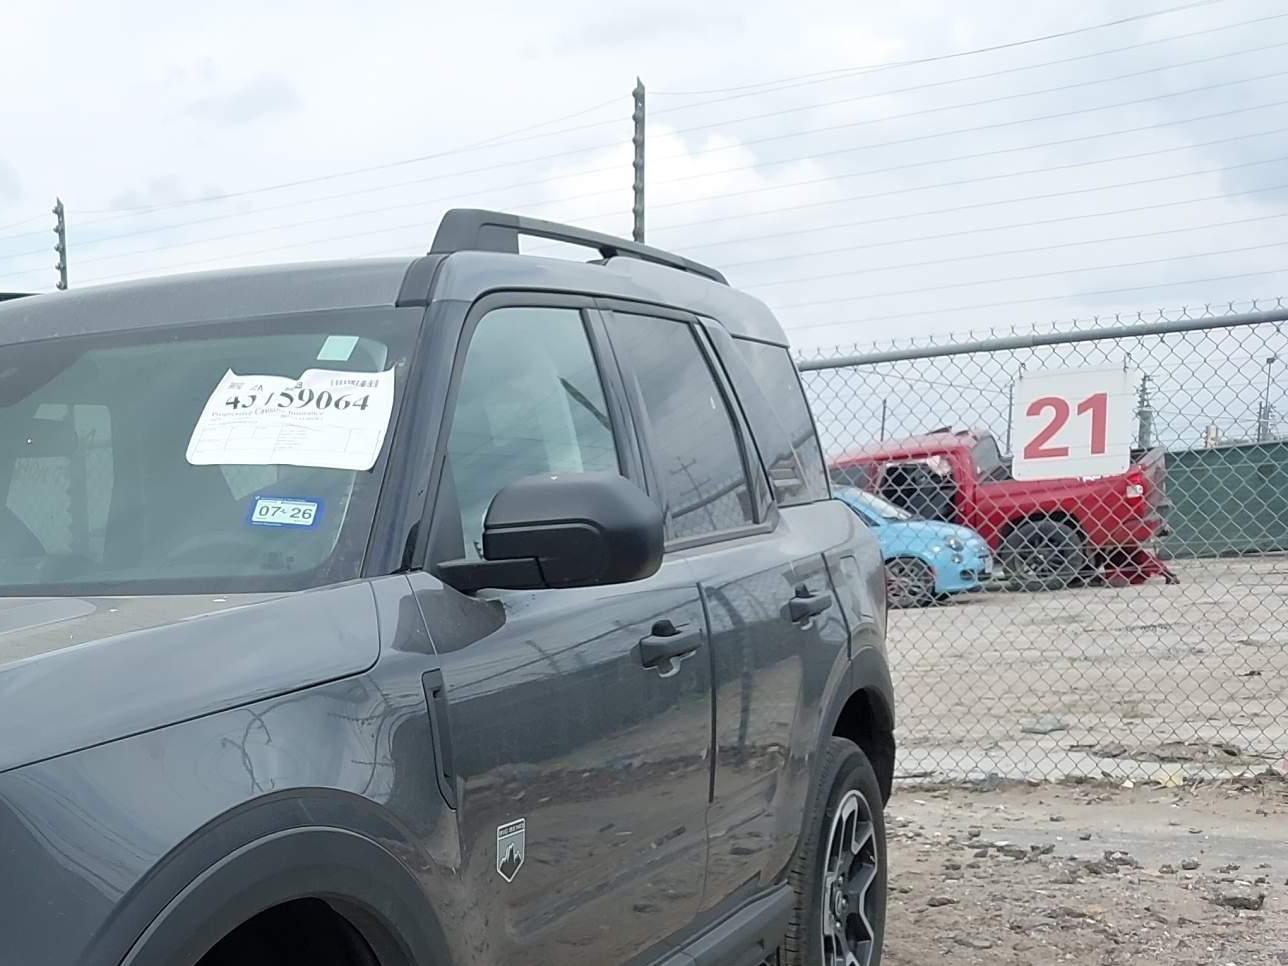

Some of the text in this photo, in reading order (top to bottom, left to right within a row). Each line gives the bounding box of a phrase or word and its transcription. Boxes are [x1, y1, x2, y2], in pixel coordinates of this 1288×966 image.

[1024, 392, 1108, 460] 21
[259, 505, 313, 520] 07 26
